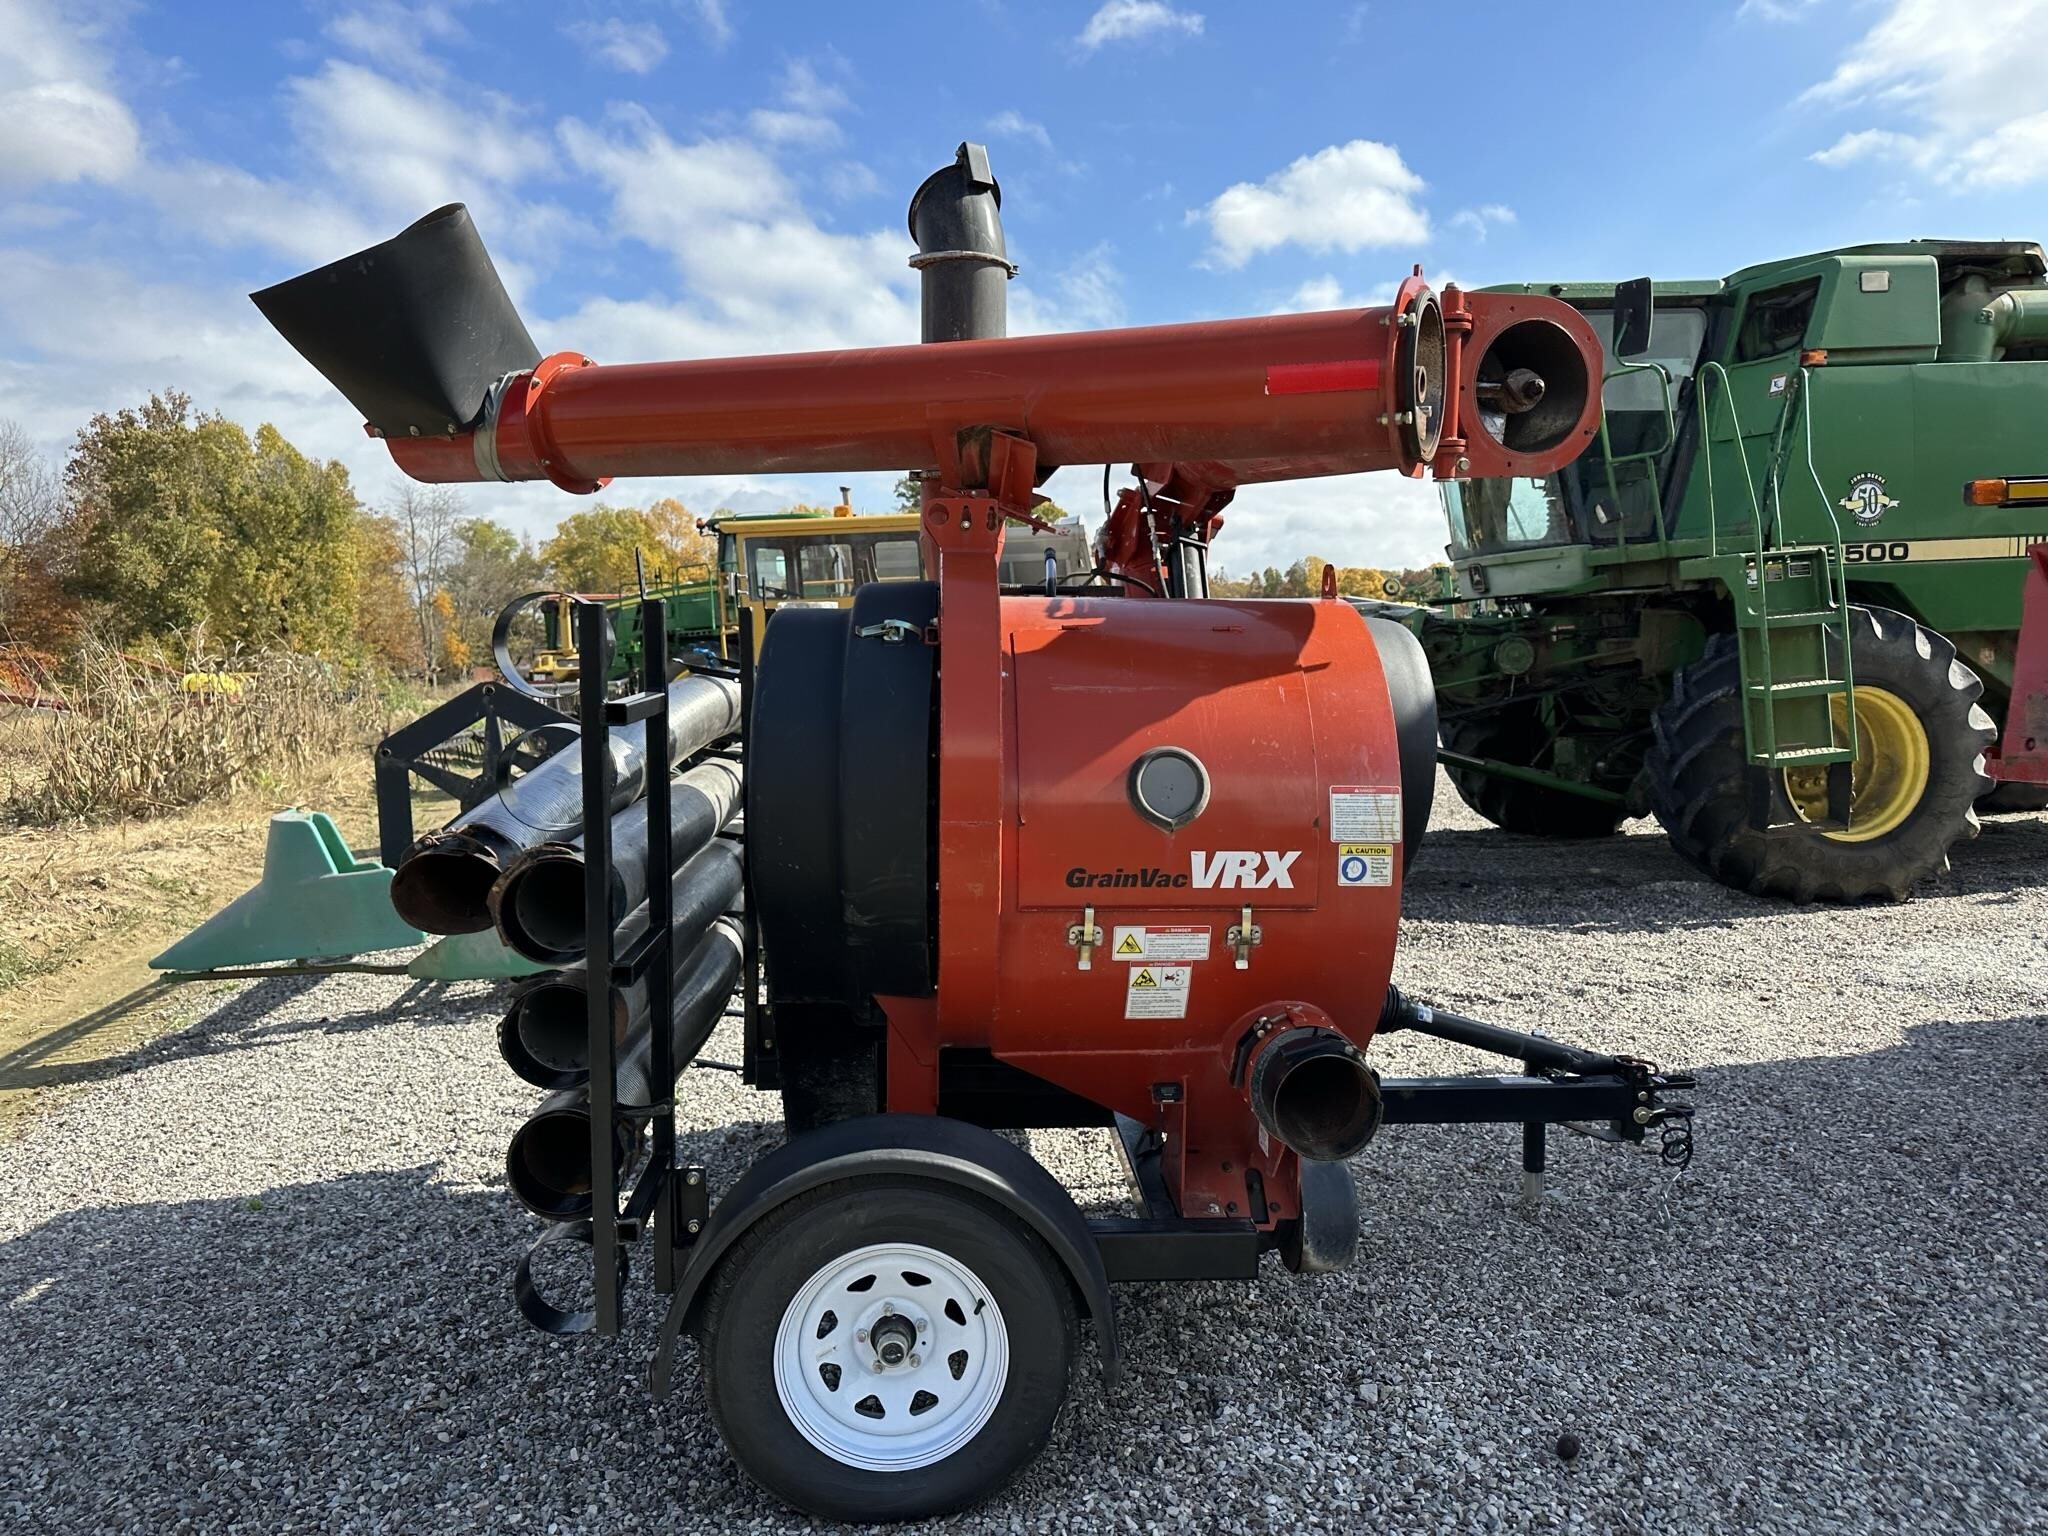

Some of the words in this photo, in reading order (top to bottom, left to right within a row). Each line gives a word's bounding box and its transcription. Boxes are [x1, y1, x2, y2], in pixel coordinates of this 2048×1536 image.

[1858, 487, 1878, 514] 50
[1065, 867, 1188, 888] GrainVac
[1191, 851, 1301, 889] VRX
